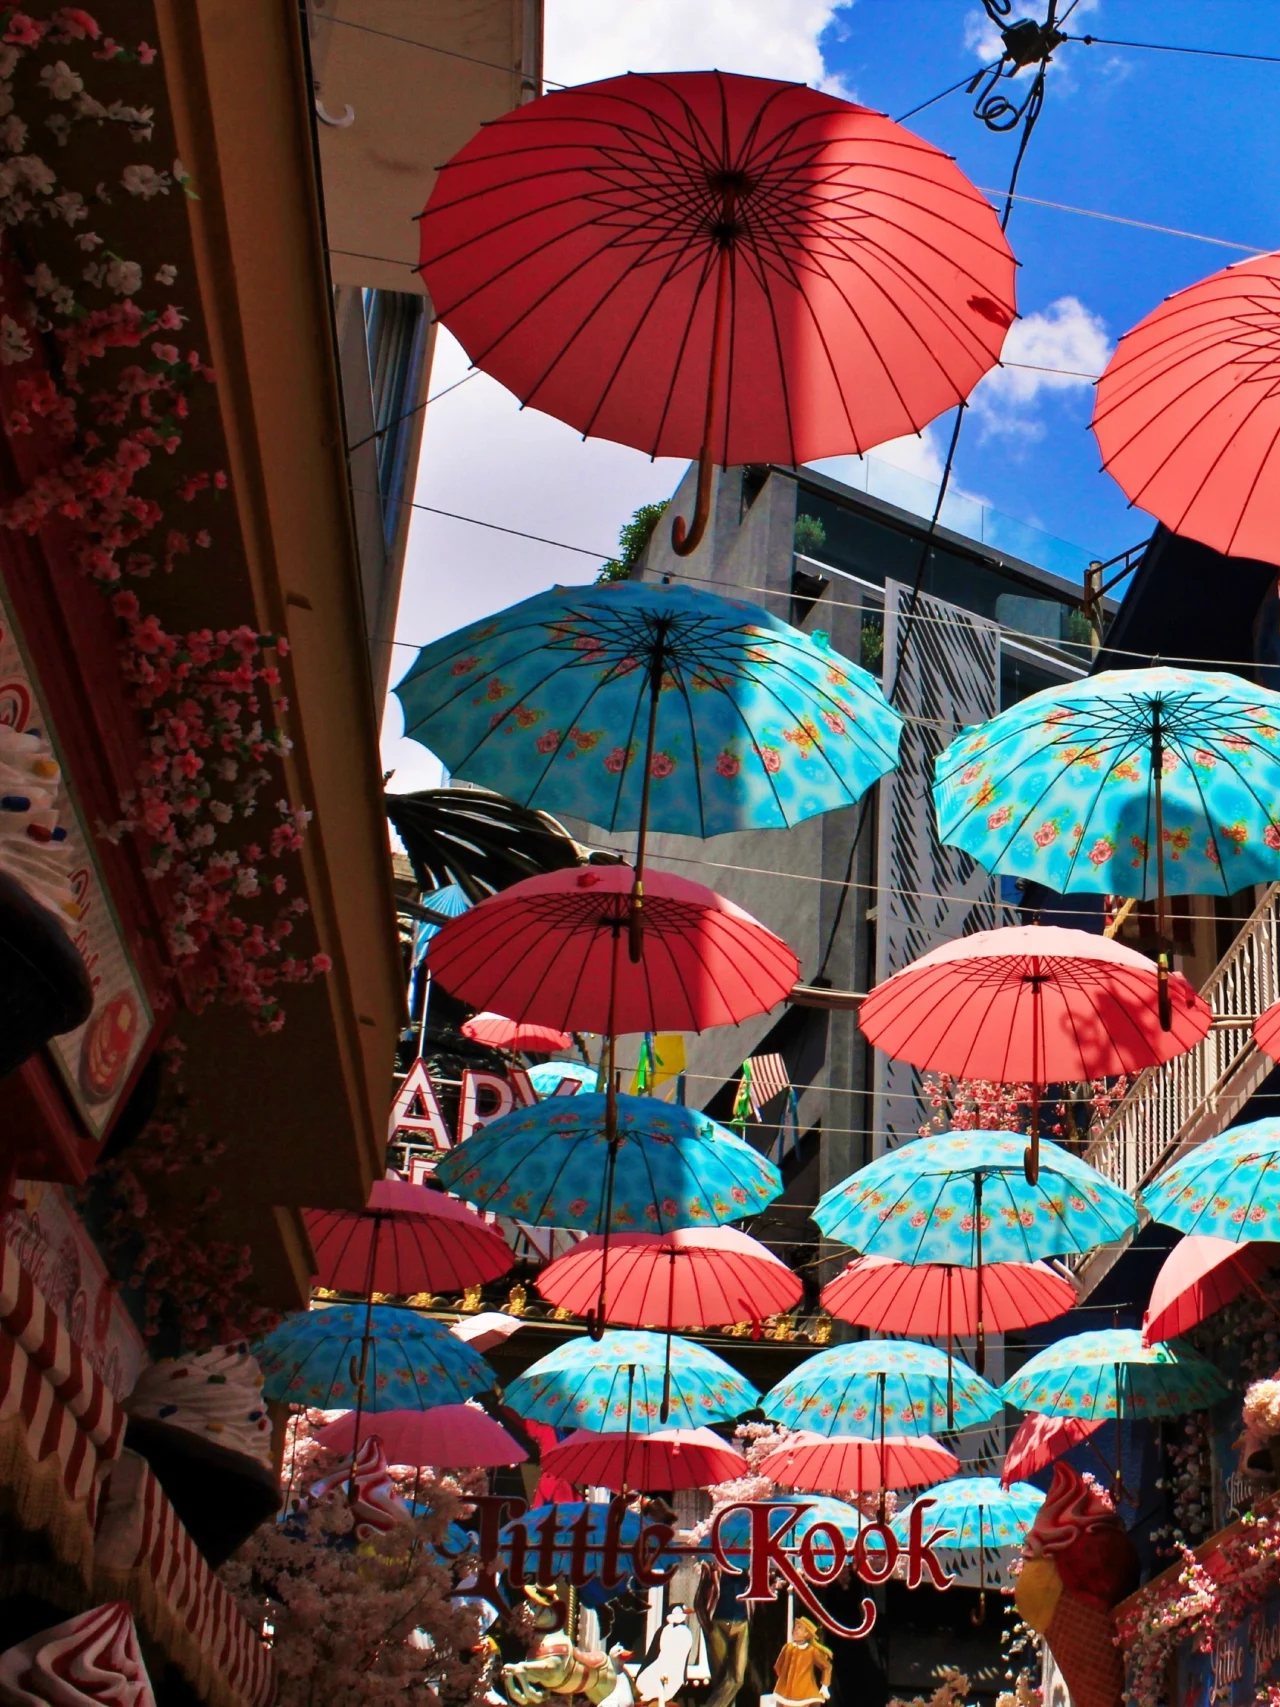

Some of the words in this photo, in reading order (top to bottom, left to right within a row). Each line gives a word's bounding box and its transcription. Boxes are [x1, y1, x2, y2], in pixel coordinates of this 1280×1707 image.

[432, 1493, 682, 1634] Little
[711, 1498, 956, 1638] Kook
[1209, 1635, 1244, 1706] Little
